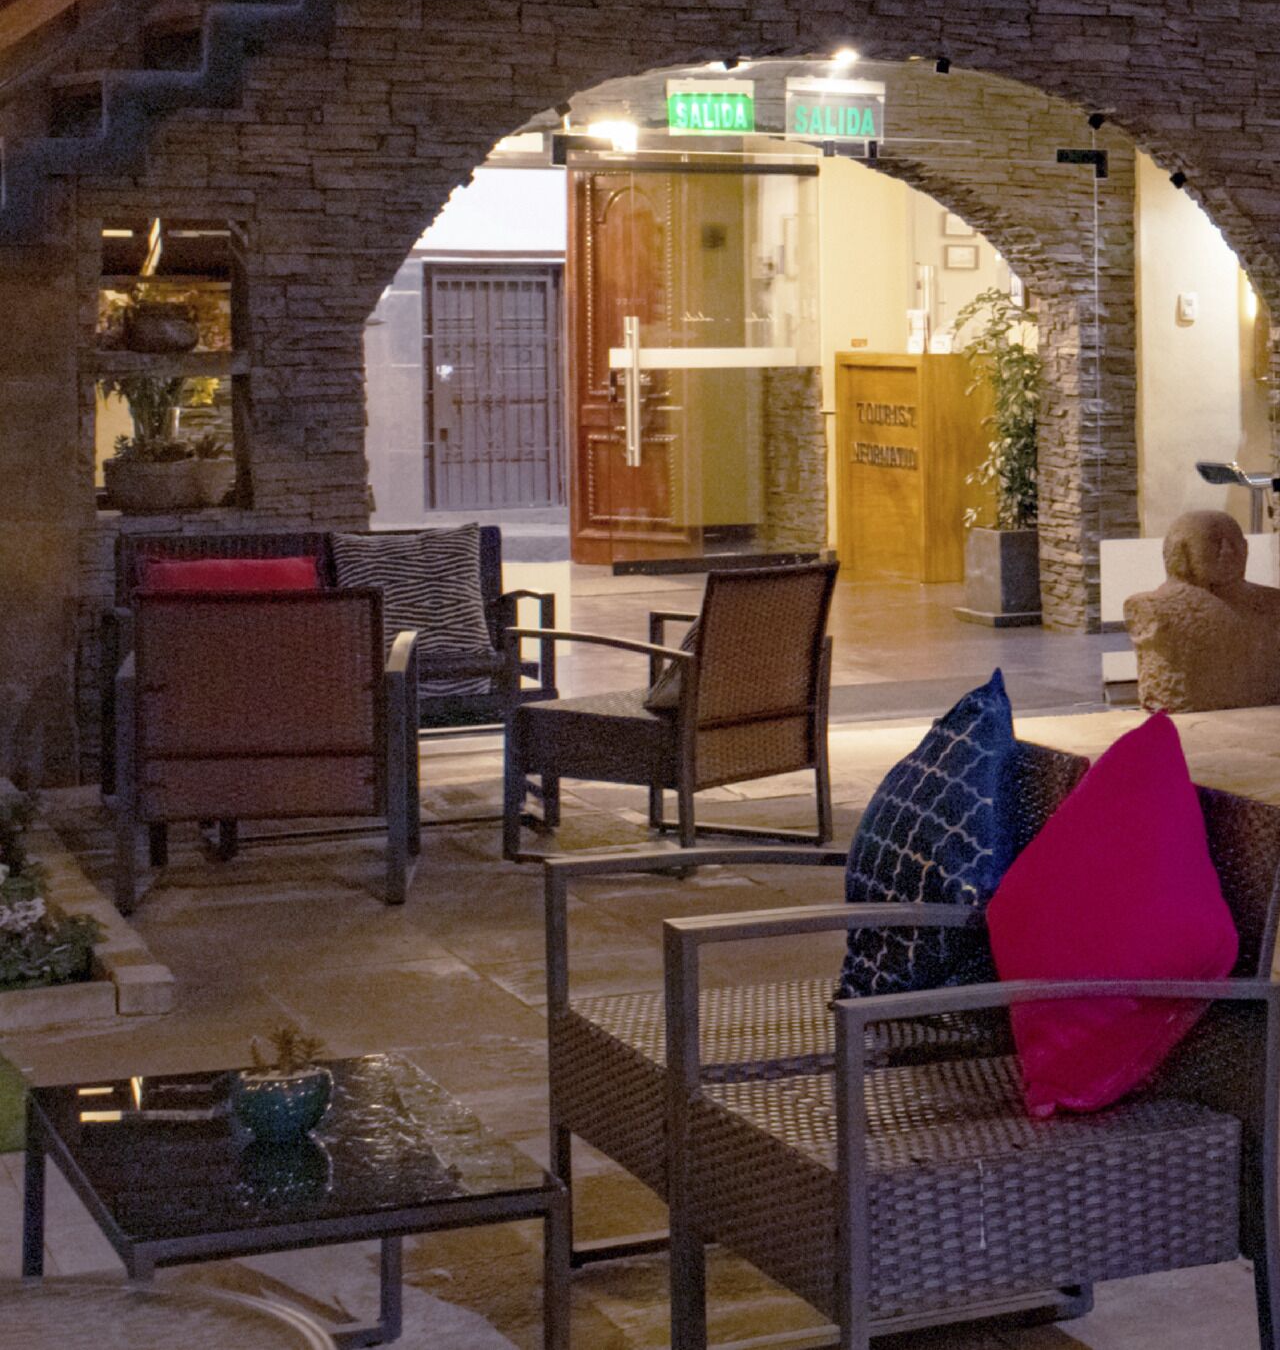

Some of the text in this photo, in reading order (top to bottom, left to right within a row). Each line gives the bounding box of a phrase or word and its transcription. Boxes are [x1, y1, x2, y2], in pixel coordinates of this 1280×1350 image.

[675, 102, 749, 128] SALIDA
[794, 105, 876, 136] SALIDA
[856, 402, 917, 428] TOURIST
